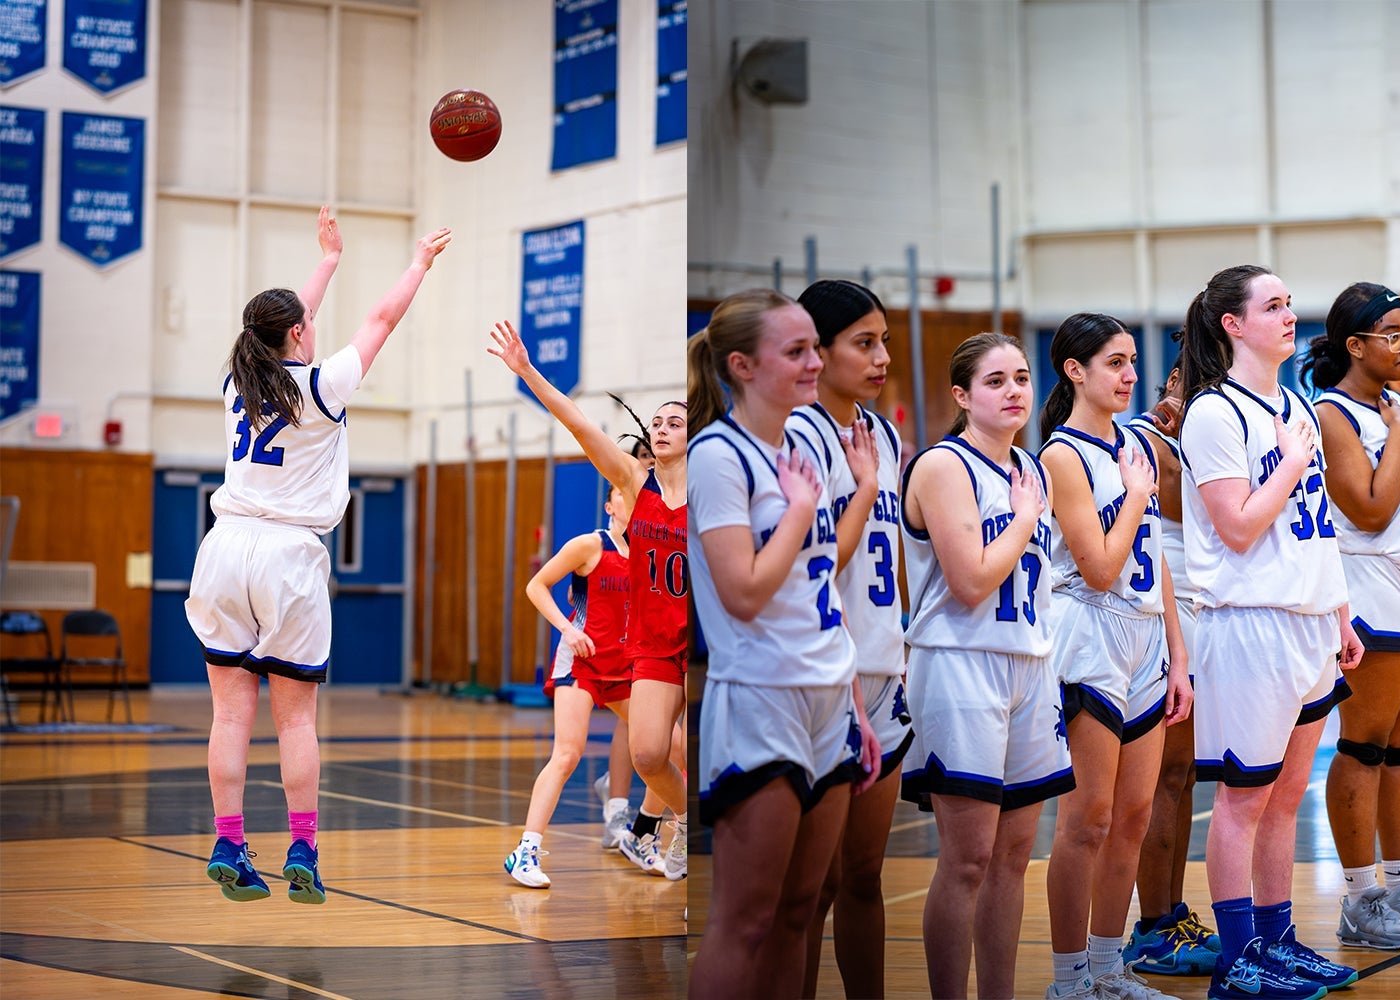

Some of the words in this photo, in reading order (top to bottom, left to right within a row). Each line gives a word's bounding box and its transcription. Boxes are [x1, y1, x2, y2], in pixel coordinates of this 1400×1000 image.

[437, 111, 488, 130] SPALDING
[230, 395, 288, 466] 32
[632, 519, 669, 541] MILLER
[1288, 473, 1337, 541] 32
[646, 548, 688, 598] 10
[807, 555, 842, 631] 2
[868, 531, 896, 607] 3
[995, 551, 1043, 627] 13
[1129, 523, 1155, 593] 5
